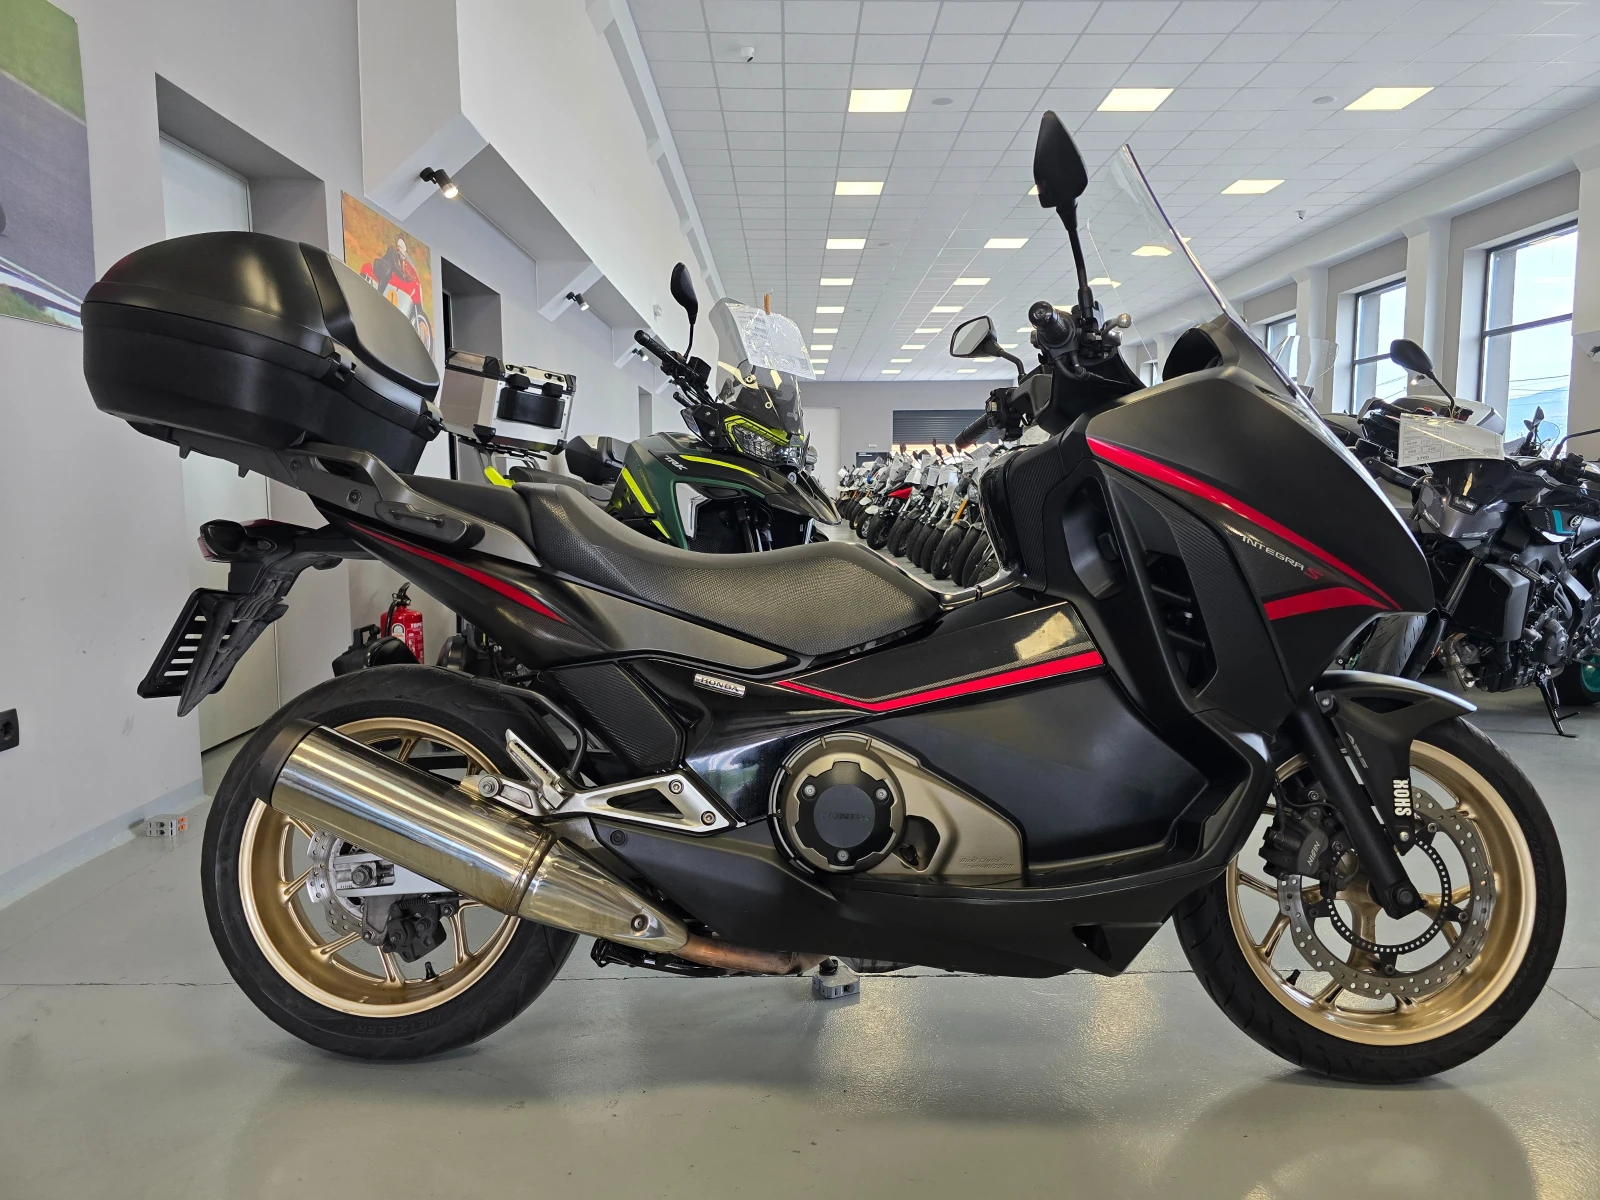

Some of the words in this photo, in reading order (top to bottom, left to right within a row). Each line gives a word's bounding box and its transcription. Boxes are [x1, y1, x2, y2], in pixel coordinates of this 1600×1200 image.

[664, 454, 688, 470] TRK
[1241, 535, 1304, 571] INTEGRA
[1303, 567, 1324, 580] S
[701, 677, 740, 692] HONDA
[1392, 779, 1412, 817] SHOX
[820, 811, 871, 821] HONDA
[355, 1012, 441, 1036] METZELER
